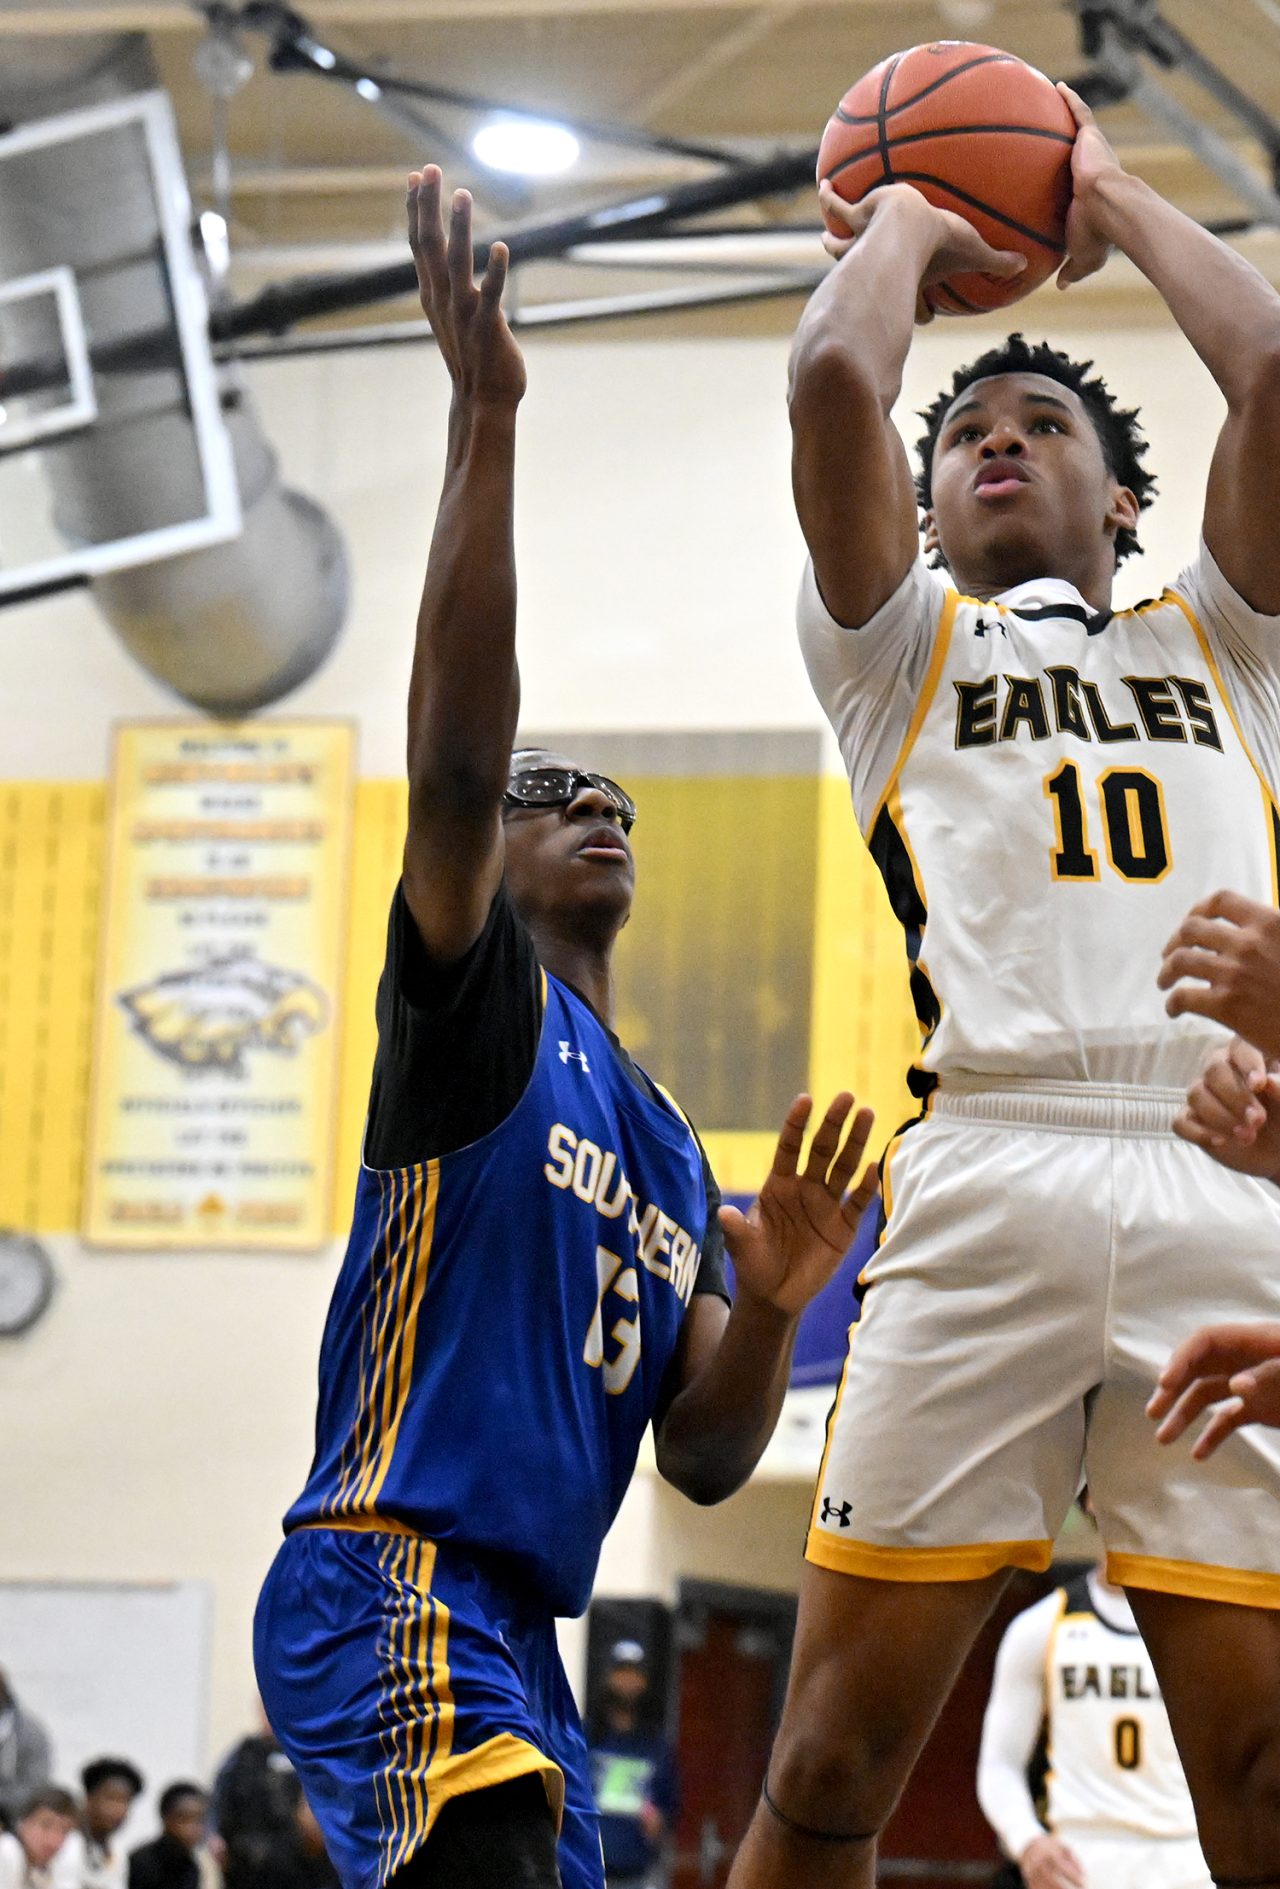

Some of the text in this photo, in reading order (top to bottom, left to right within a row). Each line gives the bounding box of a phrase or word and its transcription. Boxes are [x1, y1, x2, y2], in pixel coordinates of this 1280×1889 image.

[953, 664, 1225, 754] EAGLES
[1042, 756, 1173, 885] 10
[1110, 1713, 1144, 1773] 0
